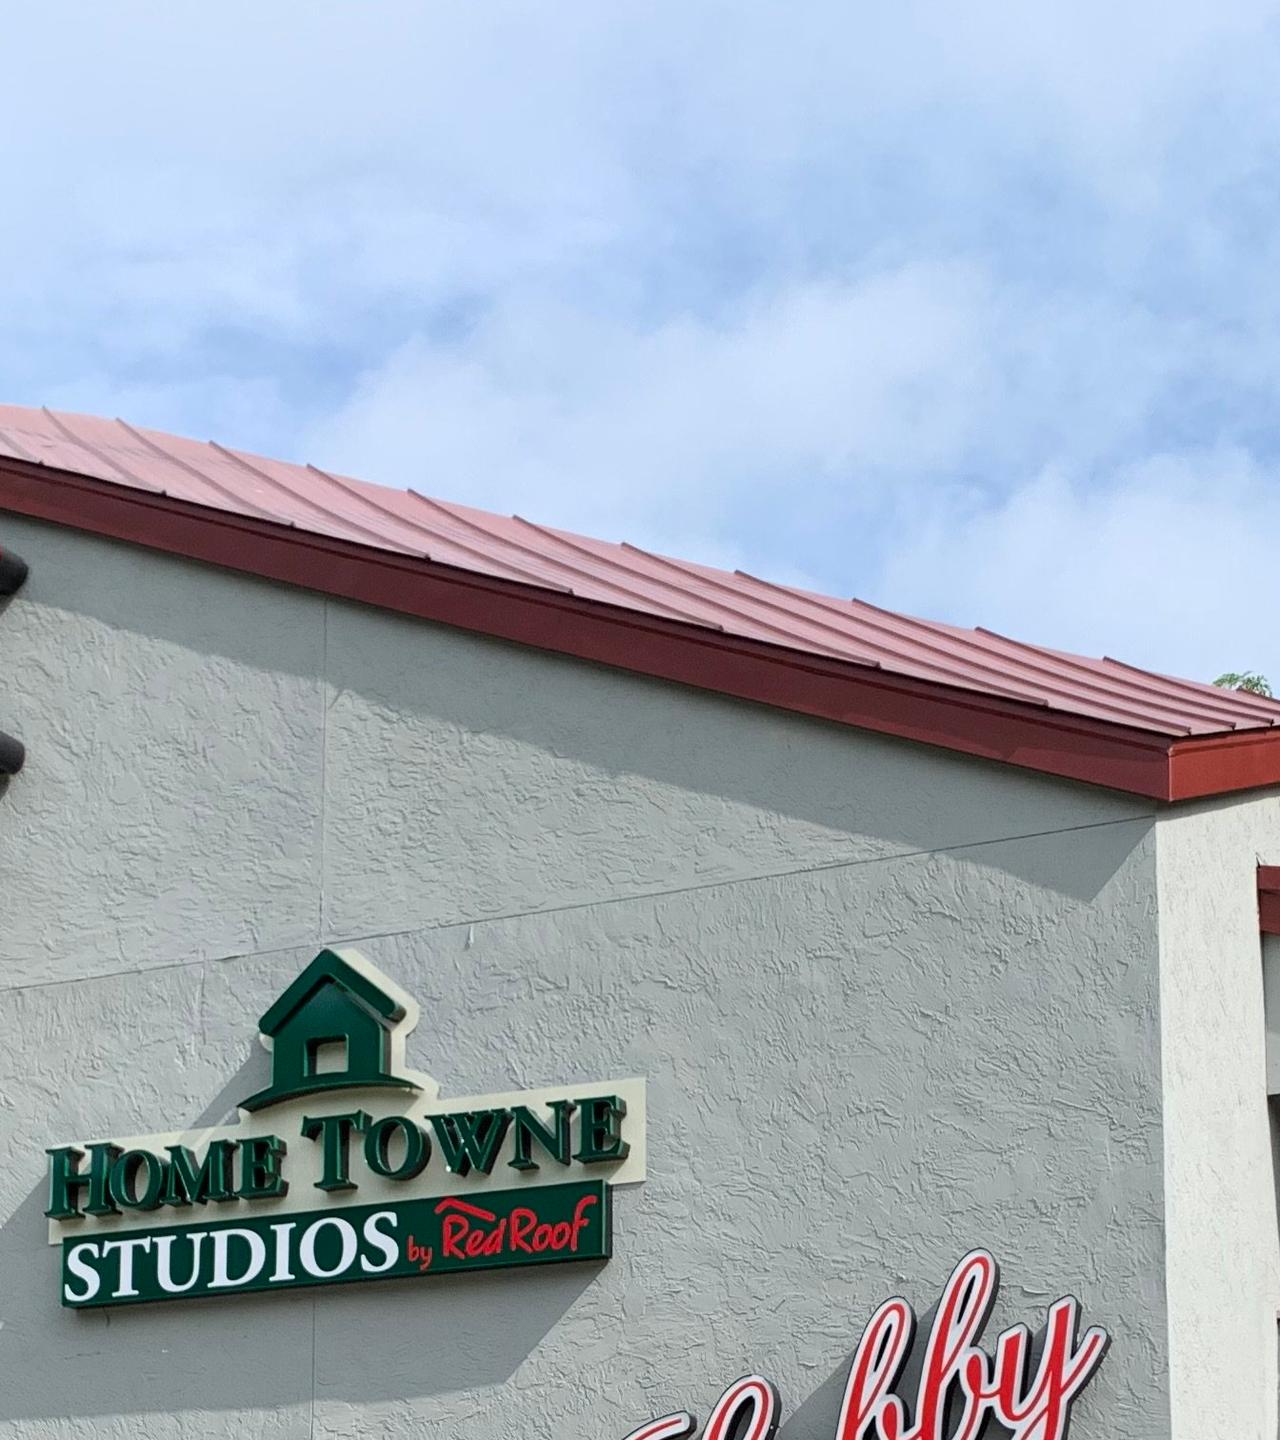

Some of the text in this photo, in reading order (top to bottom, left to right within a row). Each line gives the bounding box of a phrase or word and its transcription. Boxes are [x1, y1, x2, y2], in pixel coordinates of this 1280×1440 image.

[45, 1094, 631, 1223] HOME TOWNE
[63, 1210, 400, 1304] STUDIOS
[407, 1235, 434, 1272] by
